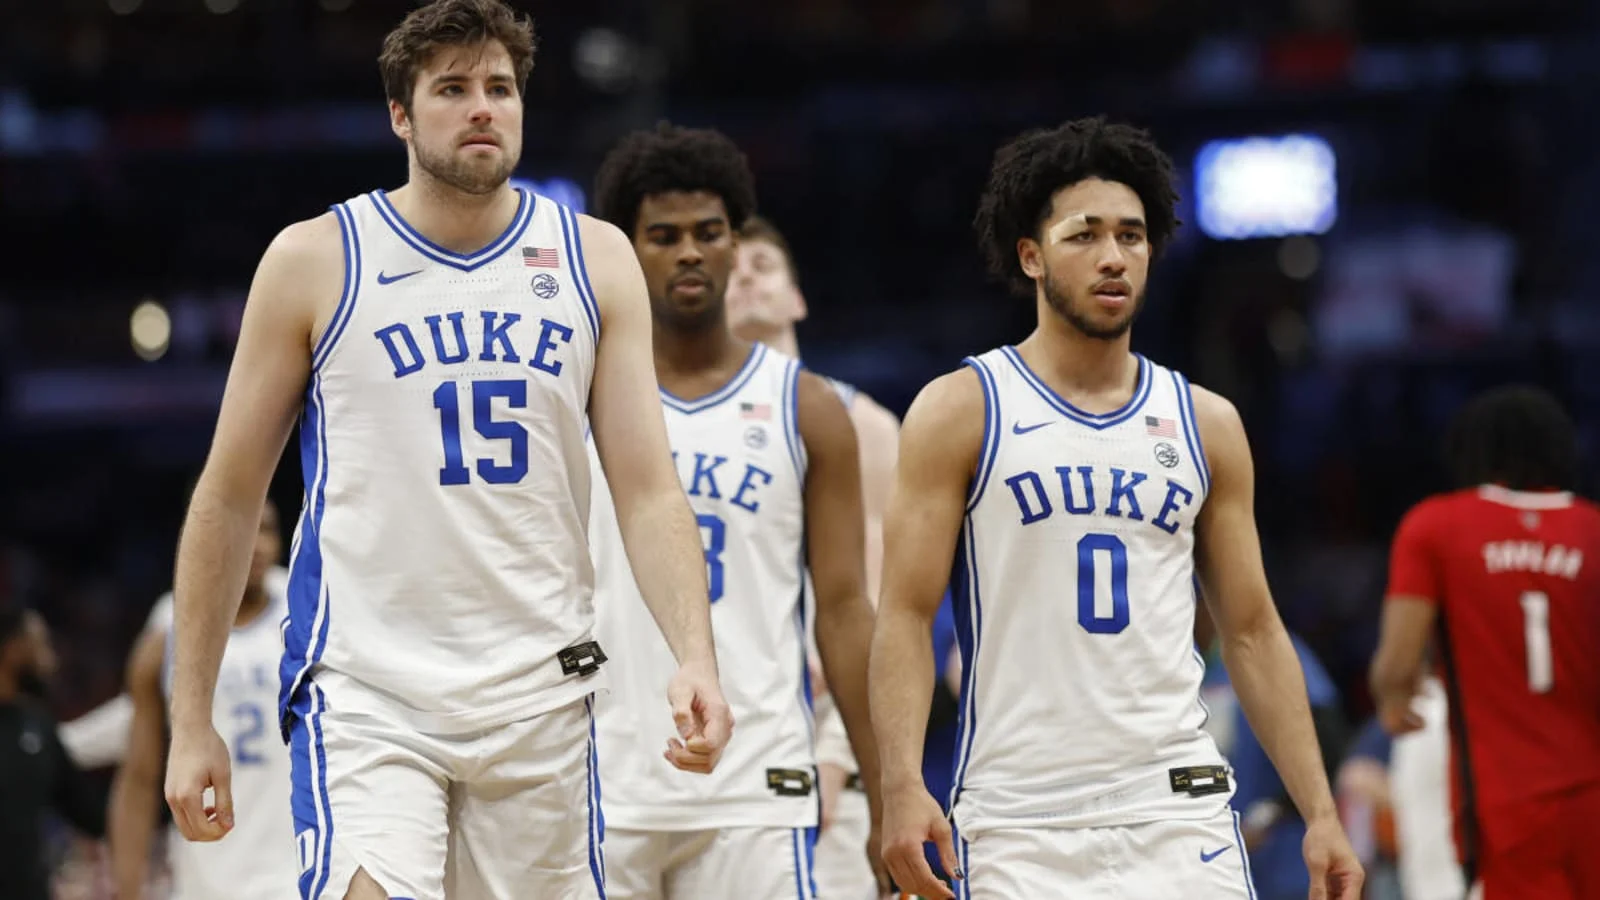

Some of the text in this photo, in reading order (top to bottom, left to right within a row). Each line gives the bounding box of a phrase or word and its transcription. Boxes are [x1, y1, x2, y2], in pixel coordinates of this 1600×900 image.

[374, 310, 574, 379] DUKE
[433, 379, 529, 486] 15
[672, 452, 773, 514] KE
[1004, 466, 1194, 535] DUKE
[1077, 533, 1131, 634] 0
[1519, 590, 1554, 694] 1
